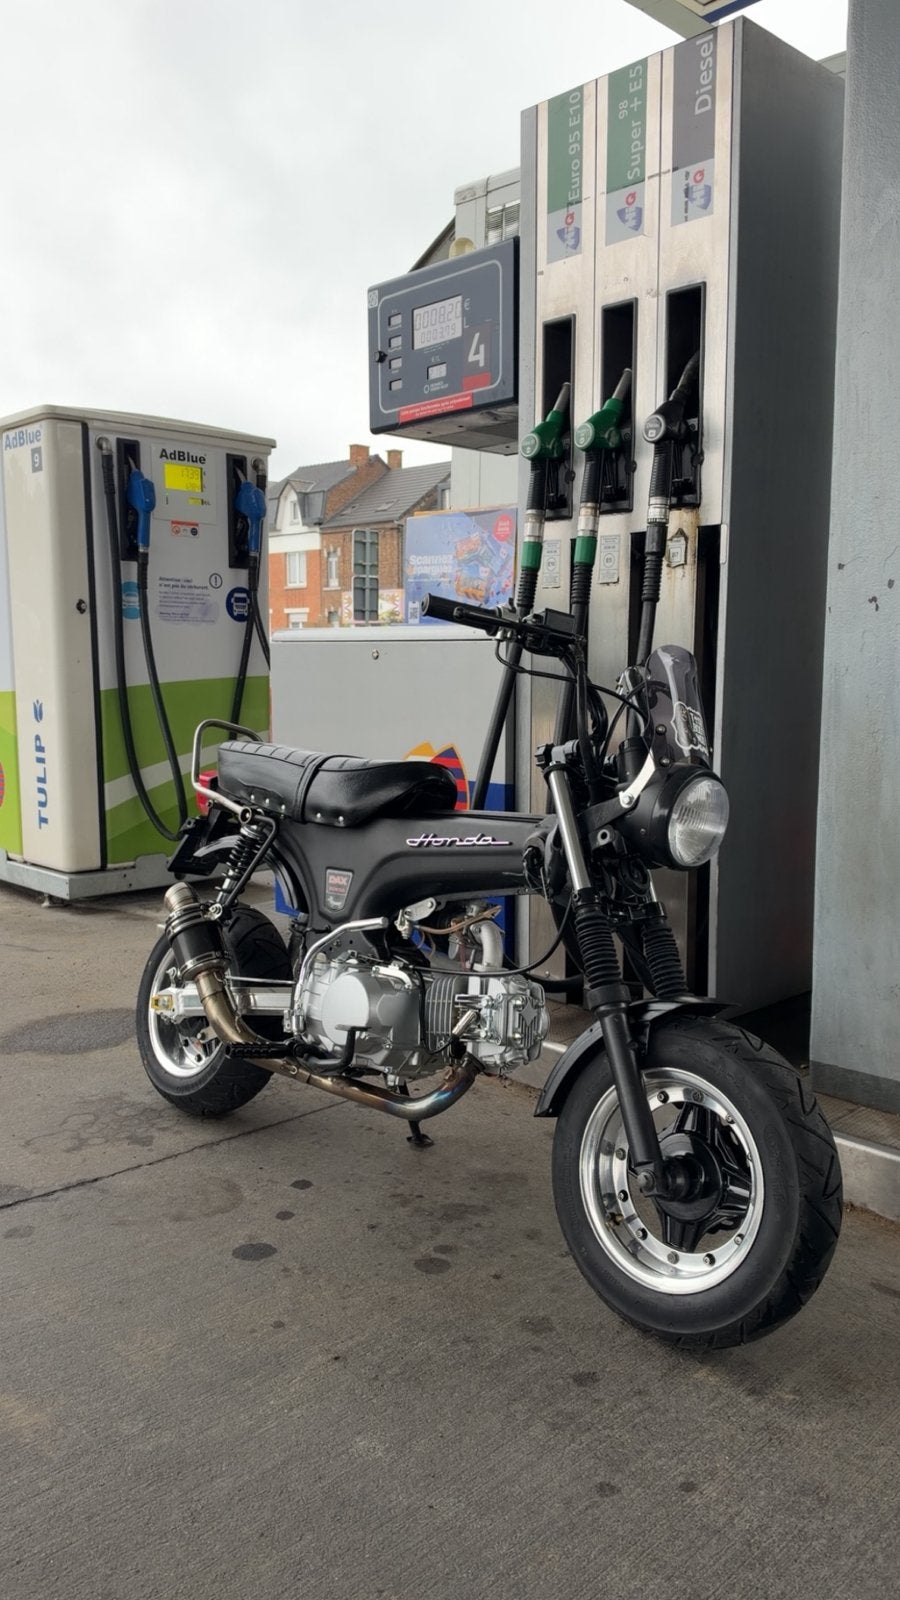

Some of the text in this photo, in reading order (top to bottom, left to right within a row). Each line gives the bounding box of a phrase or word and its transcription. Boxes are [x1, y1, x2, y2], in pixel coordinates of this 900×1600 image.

[695, 33, 714, 115] Diesel
[618, 99, 629, 119] 98
[628, 64, 645, 181] Super + E5
[568, 91, 583, 201] Euro 95 E10
[467, 332, 485, 368] 4
[4, 425, 42, 451] AdBlue
[33, 453, 40, 467] 9
[159, 448, 206, 465] AdBlue
[34, 733, 49, 830] TULIP
[406, 832, 511, 848] Honda
